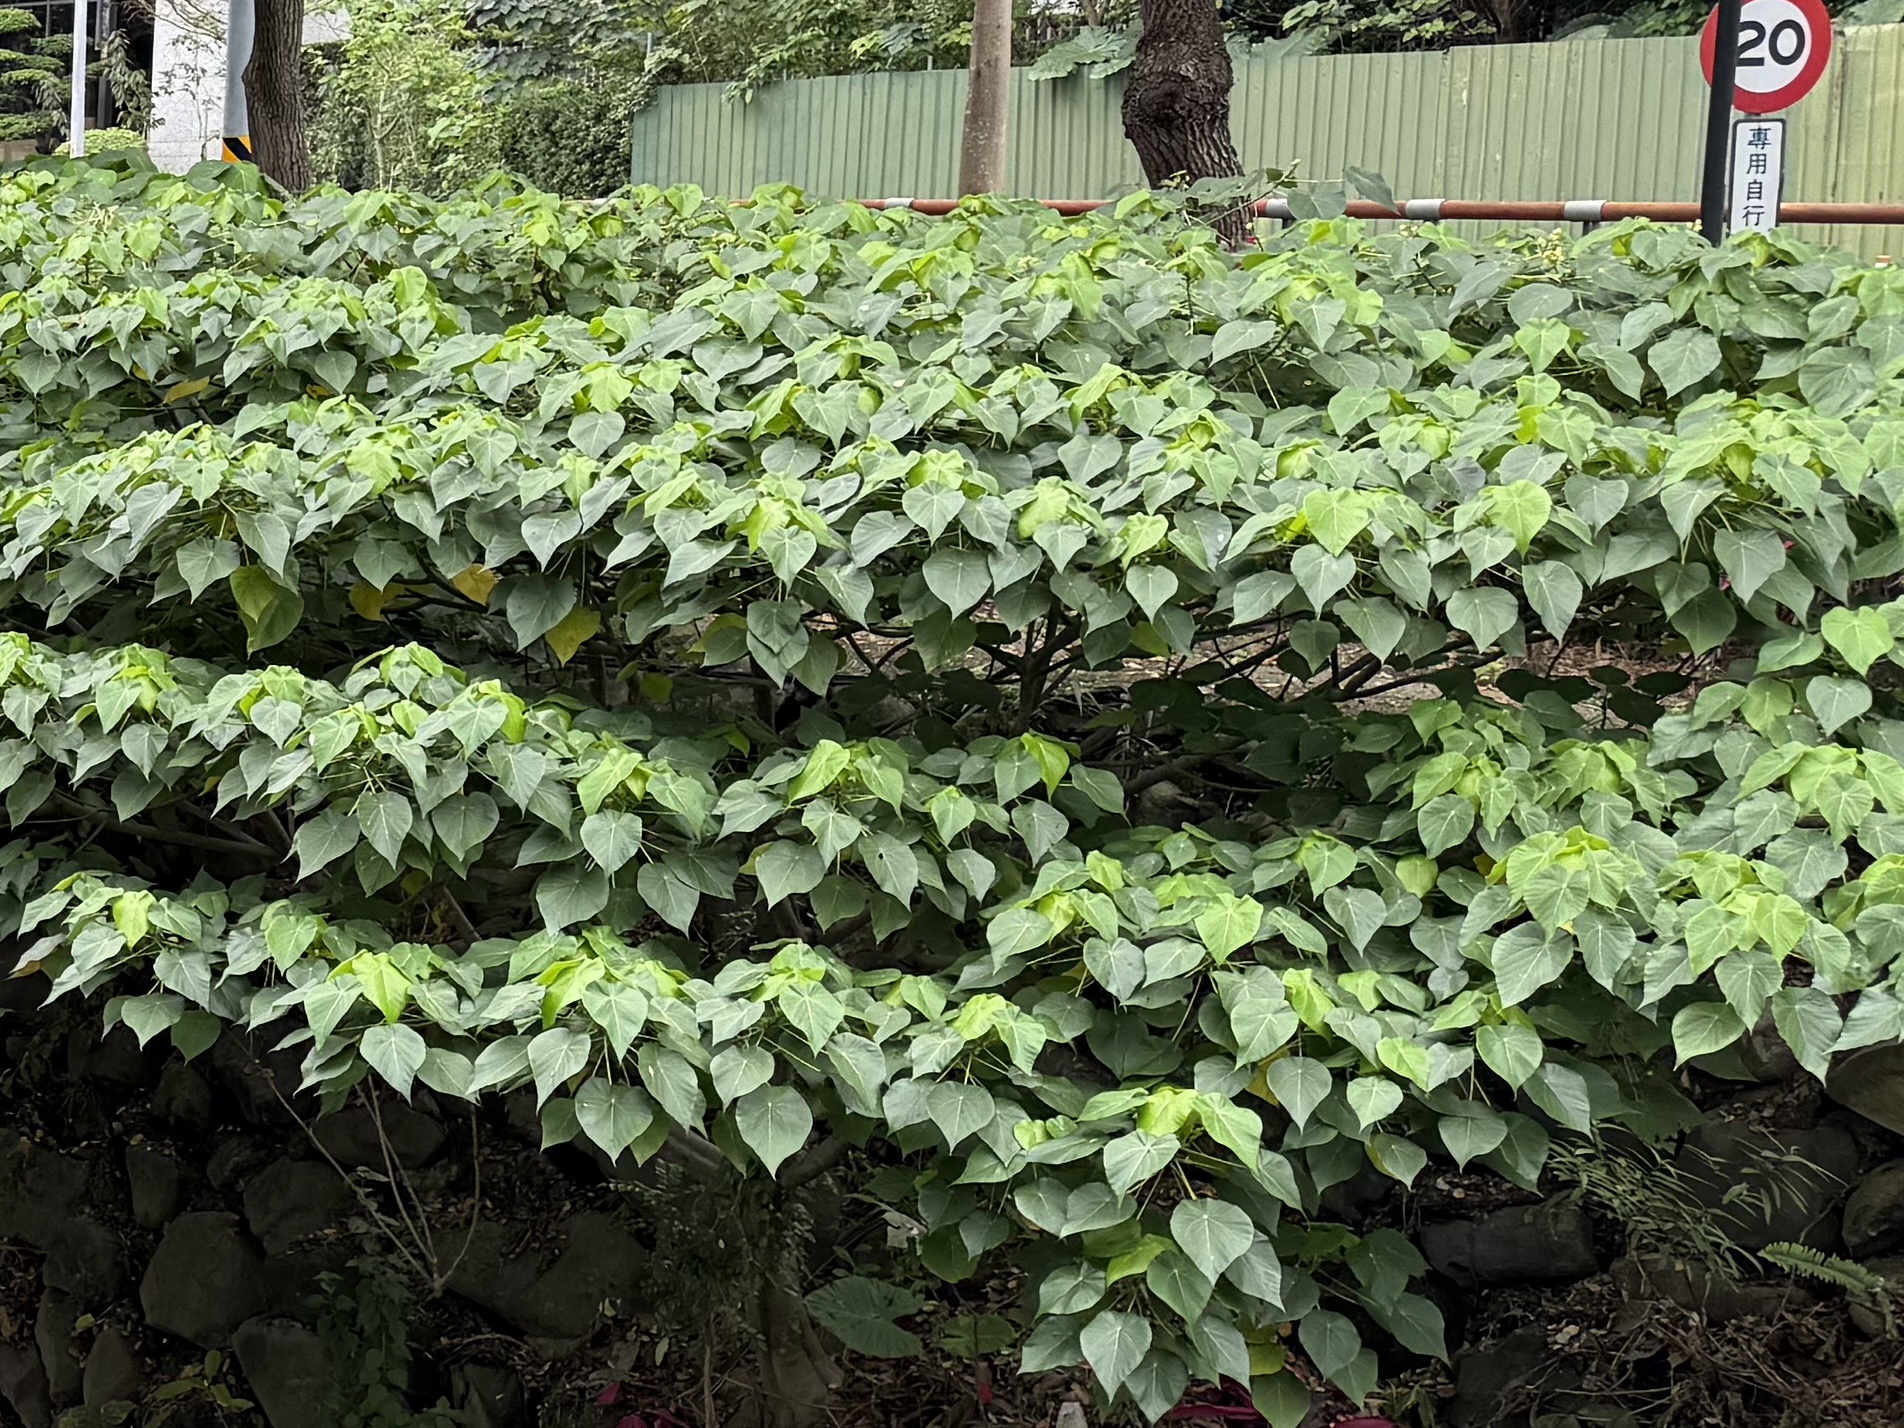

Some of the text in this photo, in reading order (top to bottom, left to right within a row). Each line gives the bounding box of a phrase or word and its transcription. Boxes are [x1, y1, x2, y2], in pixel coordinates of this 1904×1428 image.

[1735, 19, 1806, 67] 20
[1741, 126, 1773, 228] 專用自行
